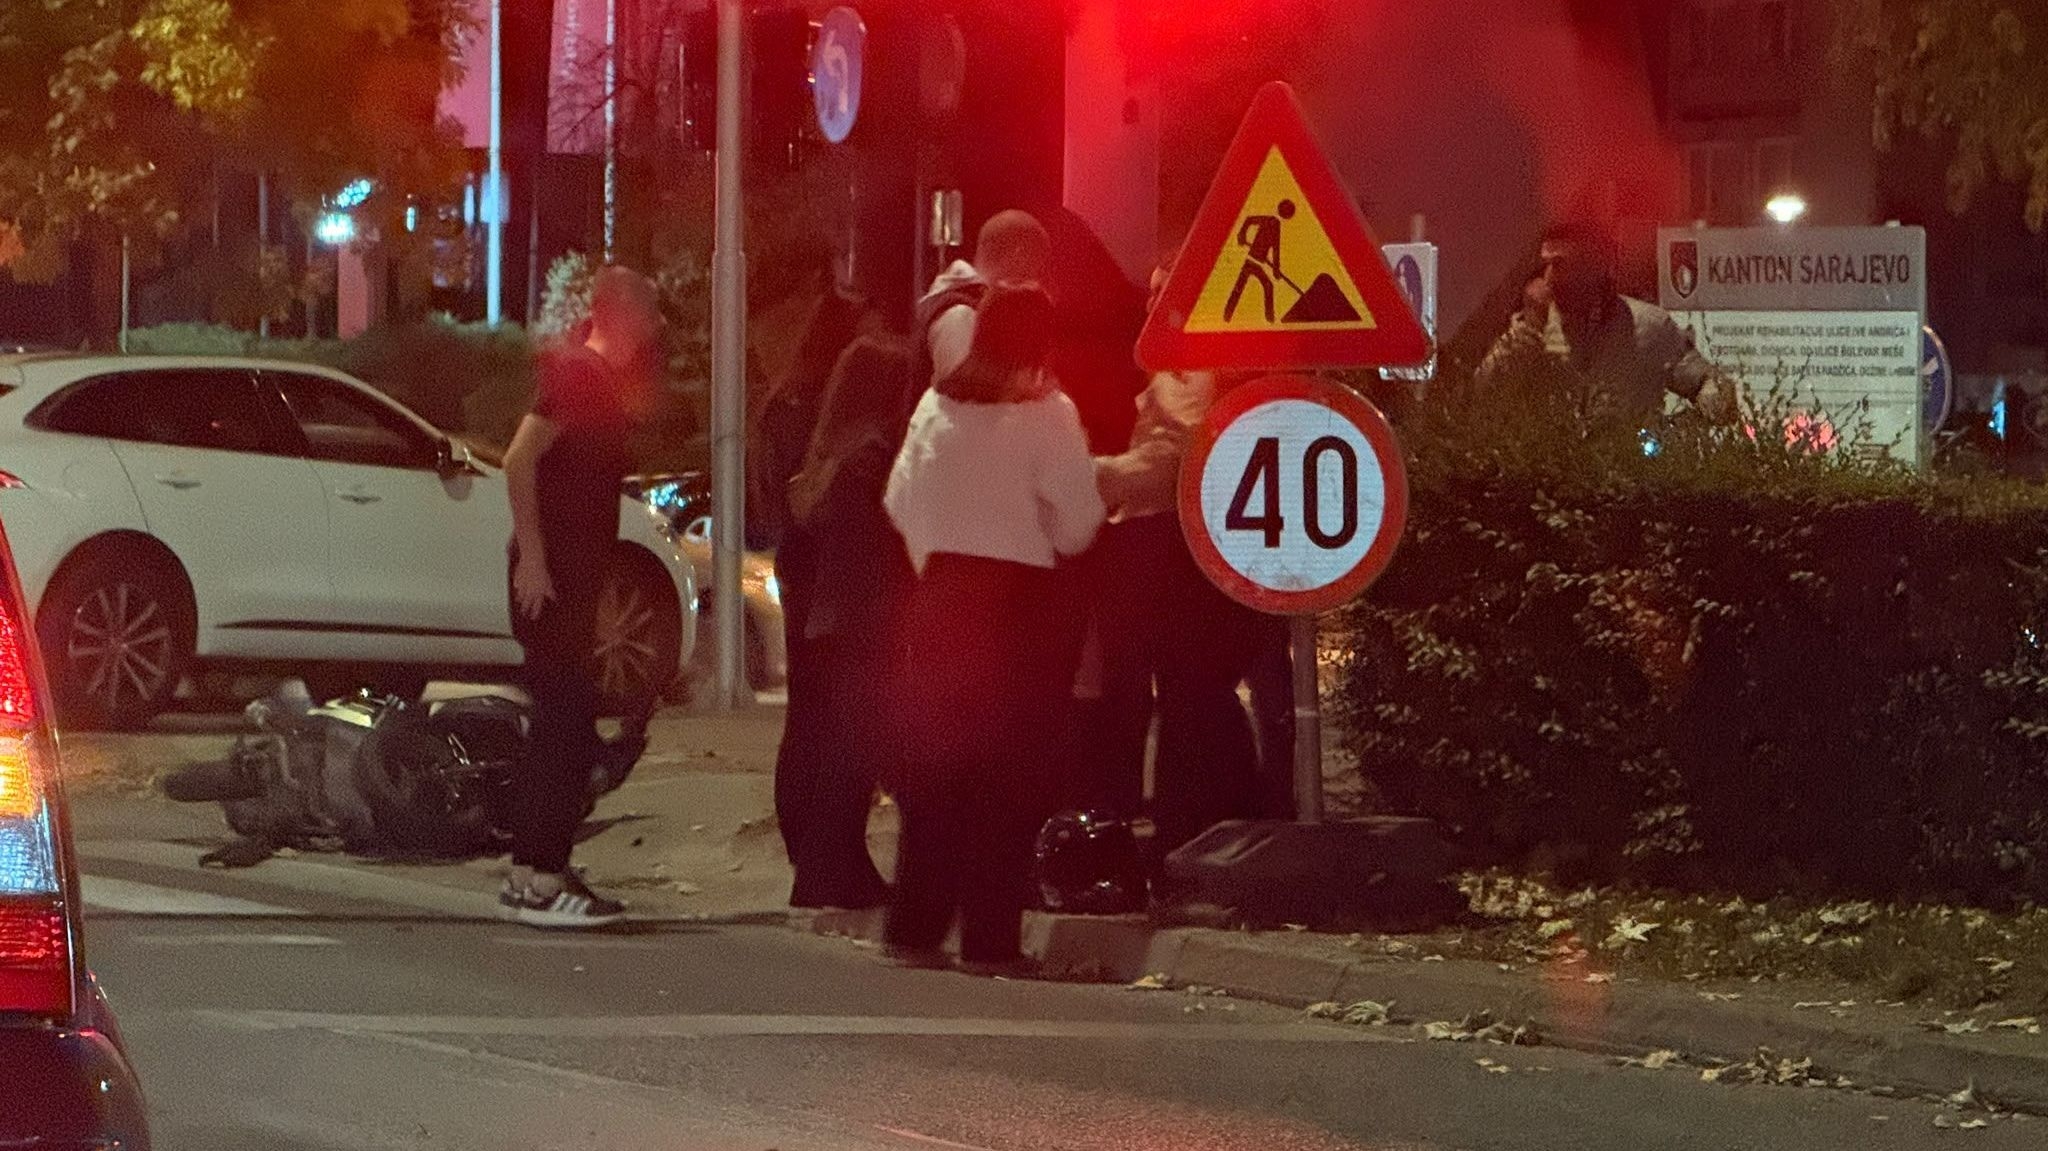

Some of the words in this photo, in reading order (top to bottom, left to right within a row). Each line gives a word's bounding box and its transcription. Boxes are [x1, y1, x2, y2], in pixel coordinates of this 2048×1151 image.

[1708, 255, 1792, 284] KANTON
[1800, 254, 1910, 284] SARAJEVO
[1826, 326, 1850, 337] ULICE
[1815, 346, 1839, 356] ULICE
[1226, 435, 1357, 549] 40
